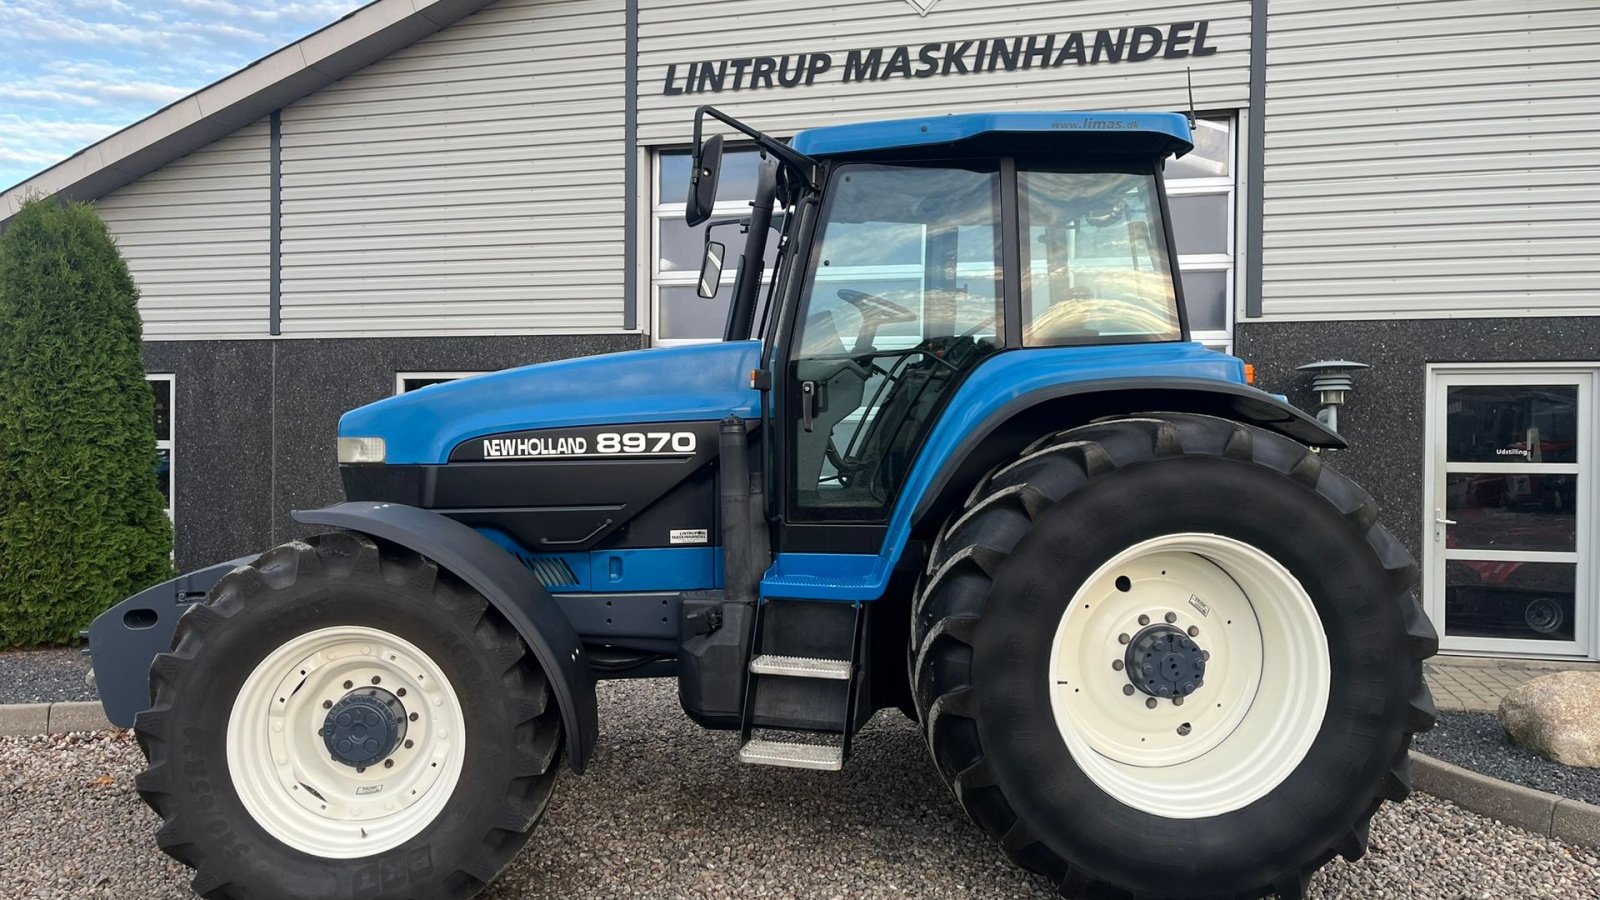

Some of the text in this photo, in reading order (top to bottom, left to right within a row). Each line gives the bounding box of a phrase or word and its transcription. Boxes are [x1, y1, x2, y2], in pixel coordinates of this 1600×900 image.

[663, 20, 1218, 96] LINTRUP MASKINHANDEL
[1051, 117, 1140, 130] www.limas.dk
[596, 431, 697, 453] 8970
[1496, 448, 1528, 456] Udstilling
